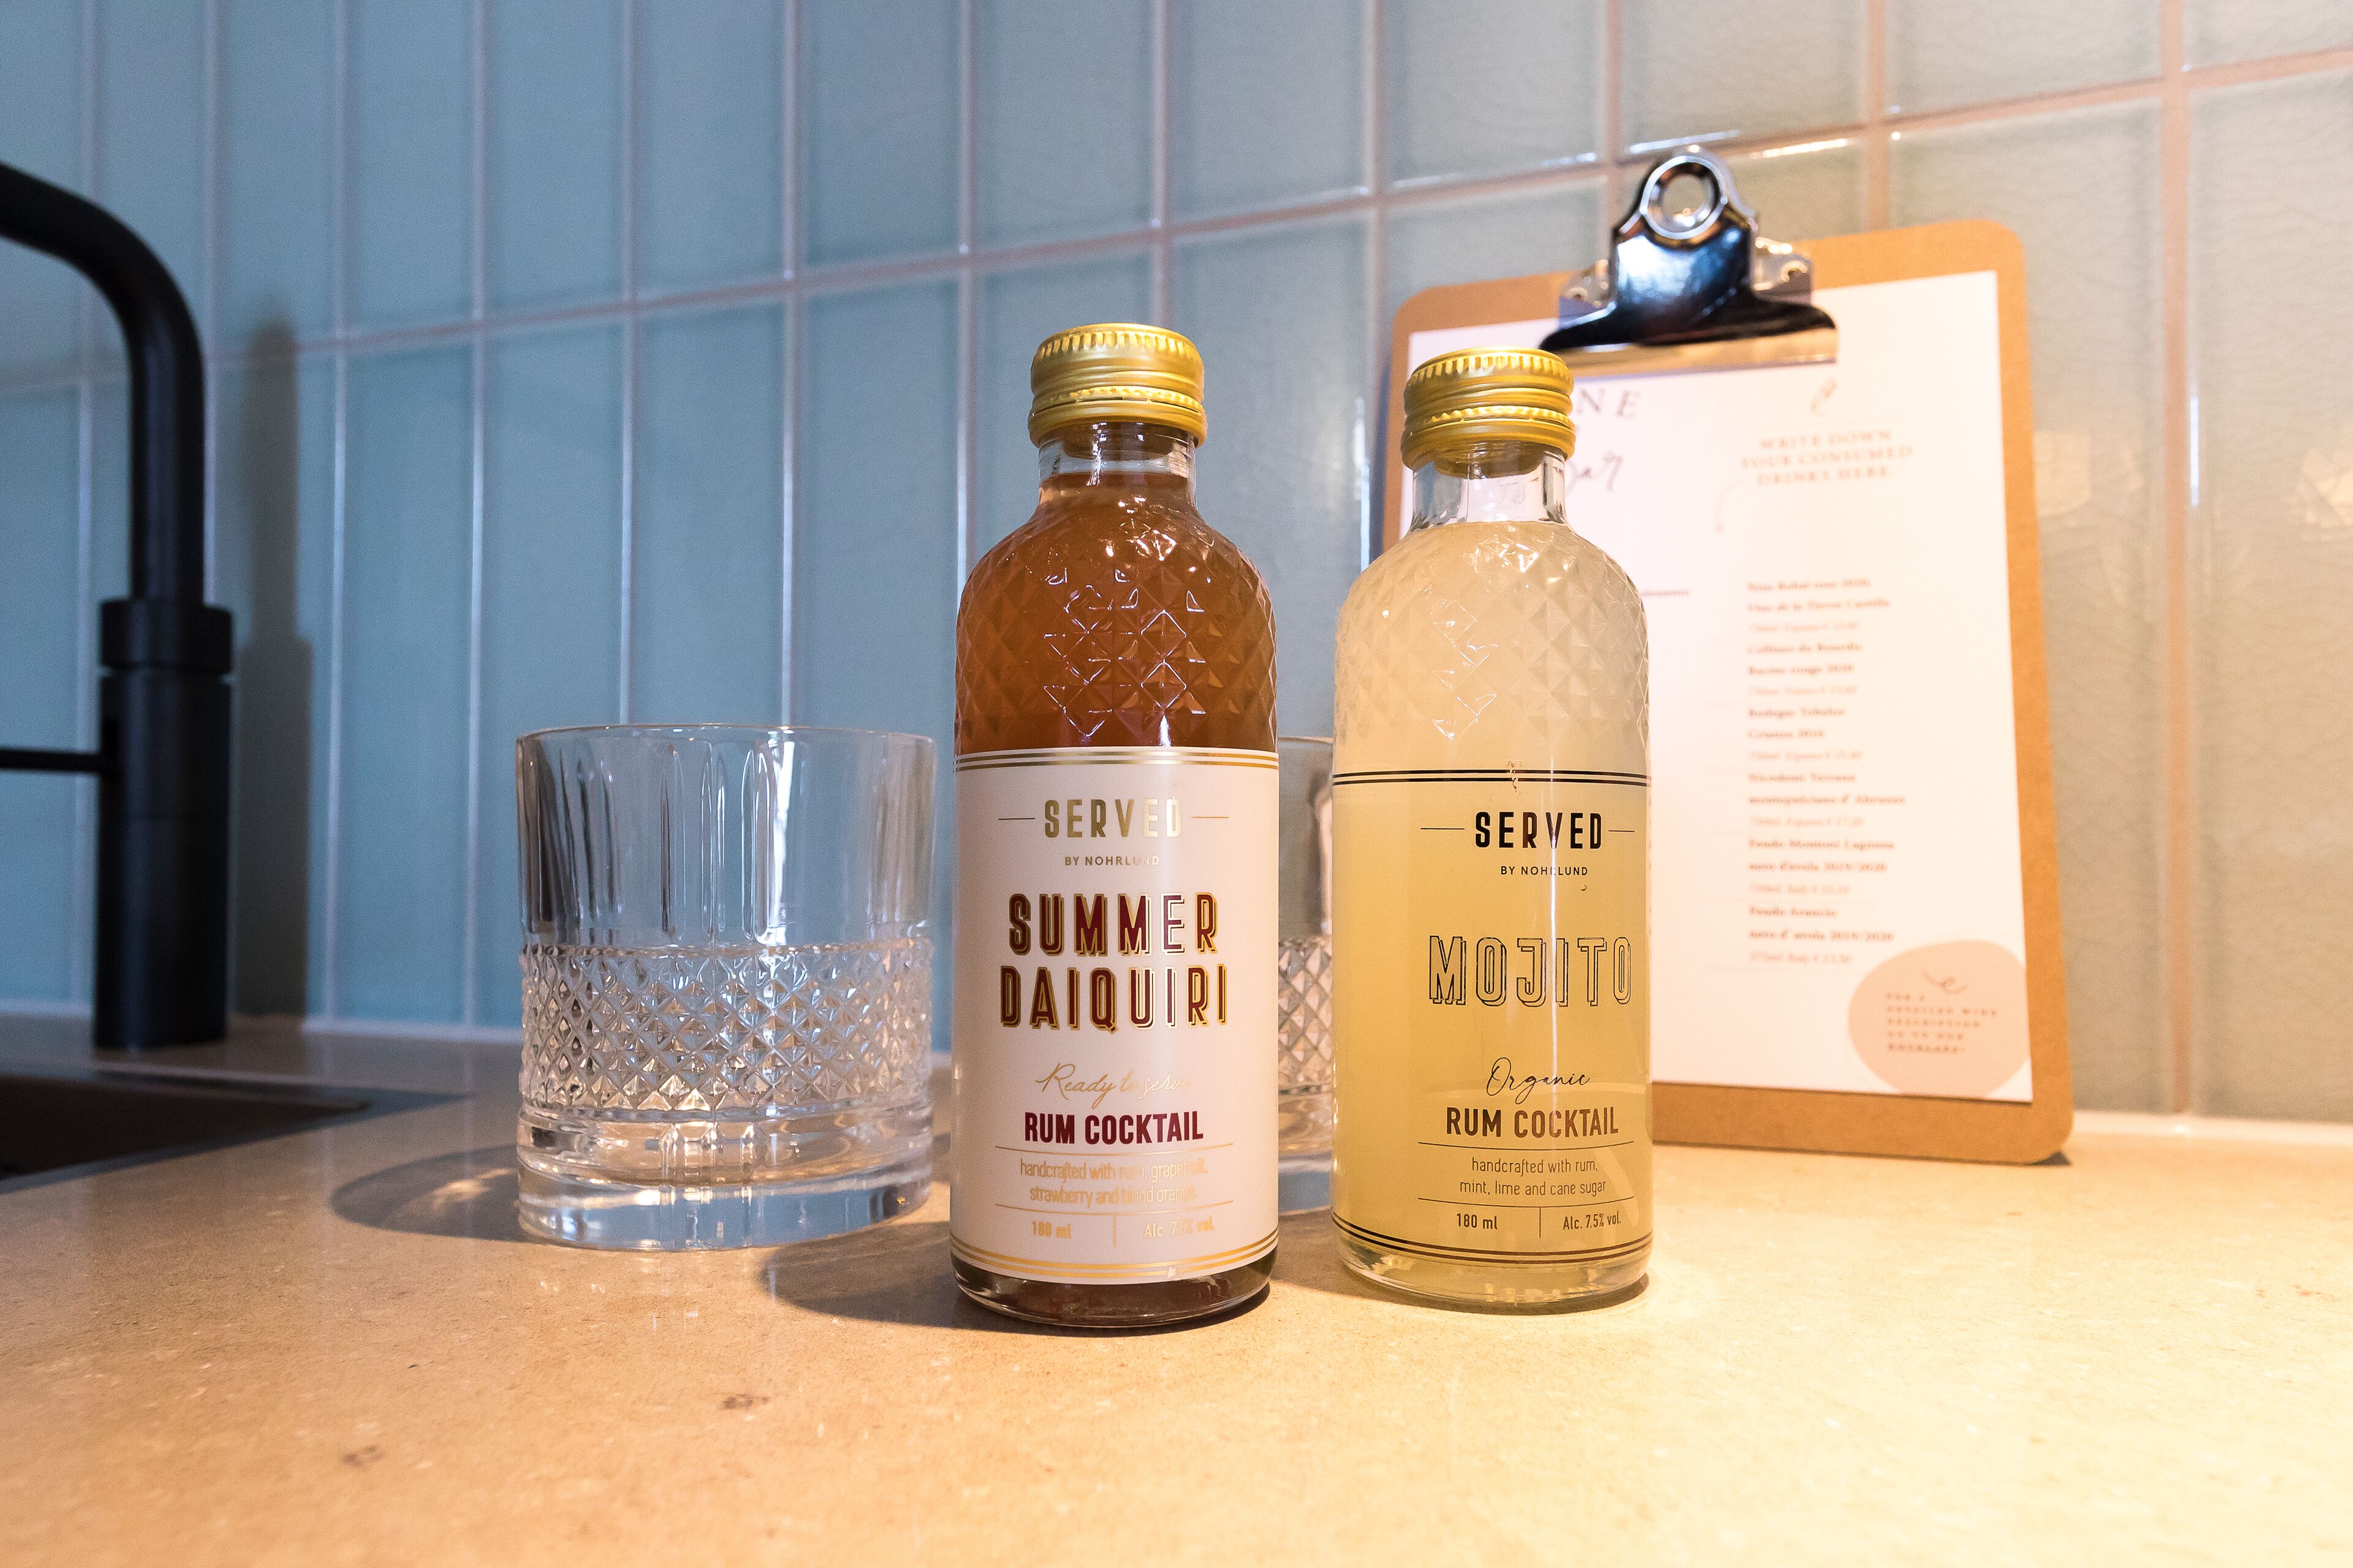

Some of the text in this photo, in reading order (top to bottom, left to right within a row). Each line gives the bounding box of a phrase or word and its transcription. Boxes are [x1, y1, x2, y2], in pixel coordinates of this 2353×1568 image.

[1759, 428, 1892, 449] WRITE DOWN
[1740, 444, 1913, 469] YOUR CONSUMED
[1757, 469, 1830, 486] DRINKS
[1044, 799, 1182, 838] SERVED
[1475, 812, 1602, 849] SERVED
[1065, 857, 1079, 865] BY
[1501, 866, 1515, 875] BY
[1009, 892, 1218, 956] SUMMER
[1429, 936, 1631, 1007] MOJITO
[1001, 964, 1228, 1034] DAIQUIRI
[1035, 1062, 1116, 1110] Ready
[1139, 1074, 1193, 1100] serve
[1487, 1057, 1591, 1105] Organic
[1025, 1110, 1203, 1145] RUM COCKTAIL
[1447, 1107, 1619, 1138] RUM COCKTAIL
[1020, 1159, 1086, 1183] handcrafted
[1089, 1162, 1116, 1180] with
[1472, 1157, 1597, 1177] handcrafted with rum,
[1029, 1186, 1093, 1208] strawberry
[1096, 1186, 1118, 1204] and
[1121, 1186, 1153, 1203] blood
[1460, 1180, 1606, 1197] mint, lime and cane sugar
[1056, 1223, 1071, 1238] ml
[1457, 1213, 1498, 1230] 180 ml
[1563, 1211, 1621, 1230] Alc. 7.5% vol.
